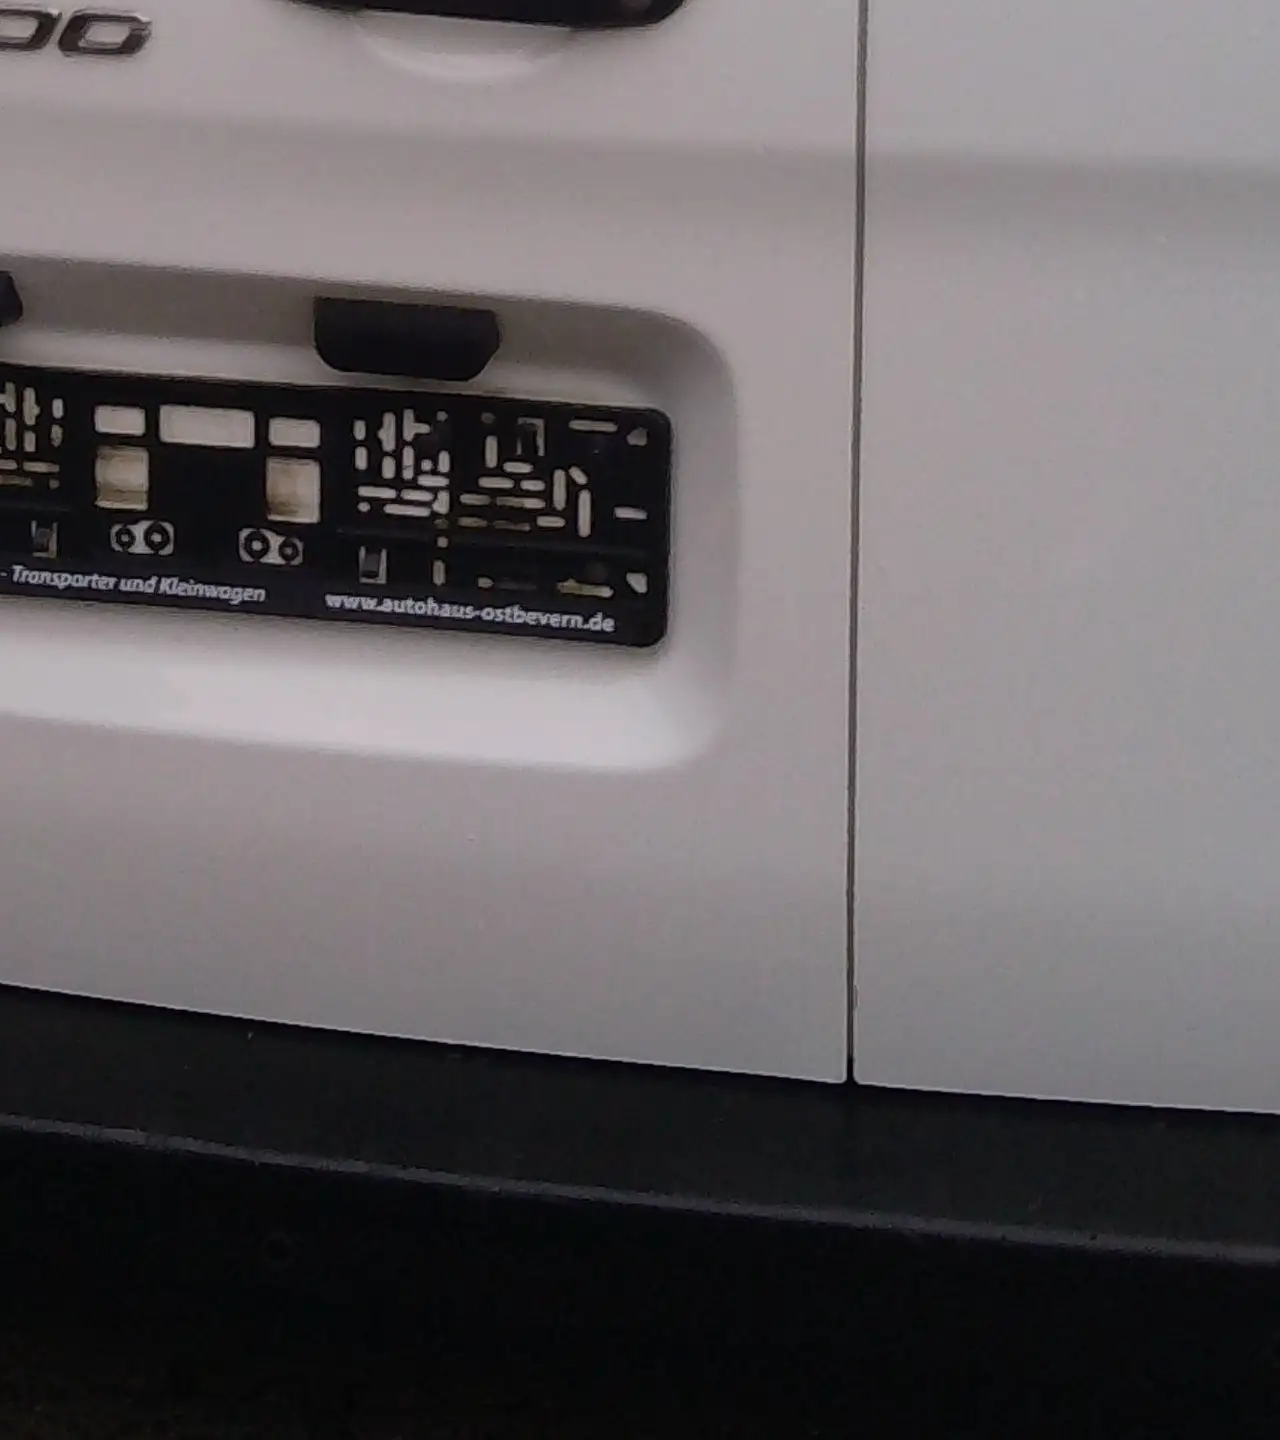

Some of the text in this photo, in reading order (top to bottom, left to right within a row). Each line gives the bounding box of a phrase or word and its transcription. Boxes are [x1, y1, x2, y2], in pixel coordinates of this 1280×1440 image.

[11, 564, 118, 592] Transporter
[119, 574, 158, 594] und
[158, 576, 266, 605] Kleinwagen
[325, 593, 615, 632] www.autohaus-ostbevern.de
